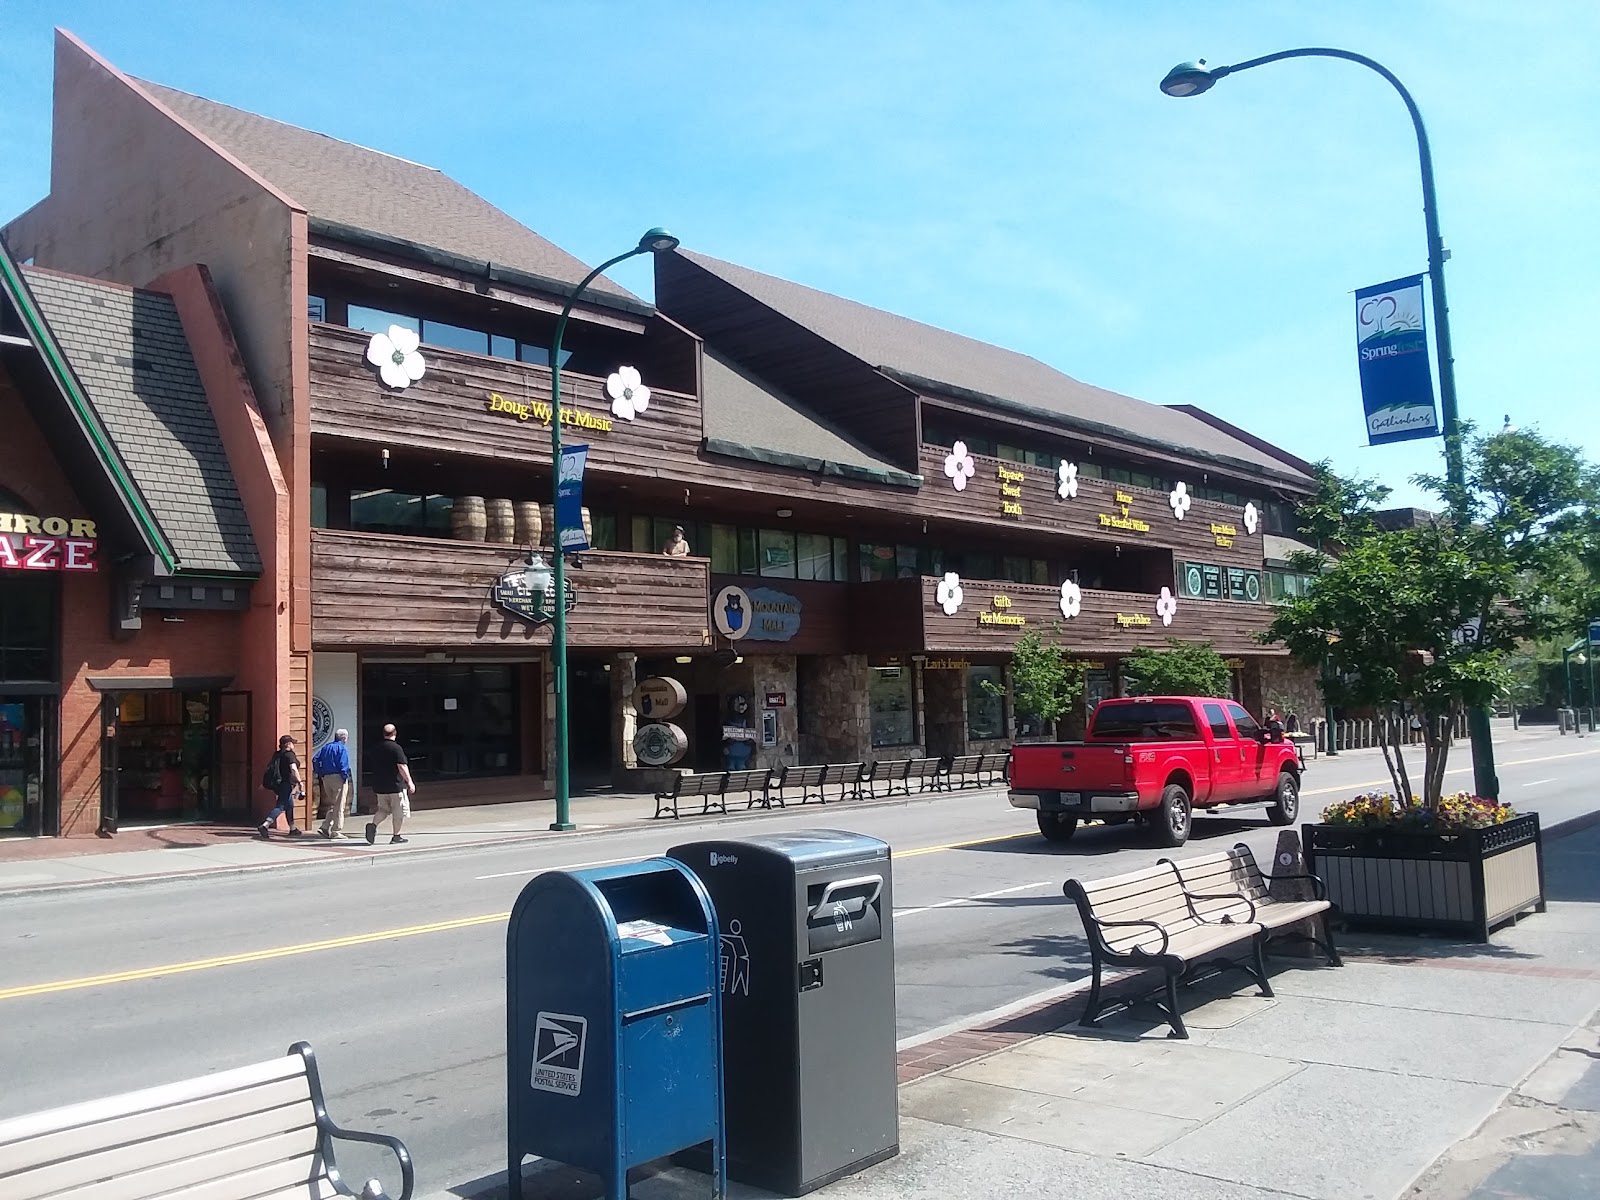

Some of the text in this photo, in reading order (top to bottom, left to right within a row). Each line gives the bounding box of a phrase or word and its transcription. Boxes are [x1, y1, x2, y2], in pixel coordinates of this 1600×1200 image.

[490, 392, 613, 432] Doug Wytt Music
[1371, 412, 1431, 431] Gatlinburg
[1002, 484, 1021, 498] Sweet
[1116, 489, 1133, 504] Home
[1003, 501, 1022, 515] Tooth
[1121, 504, 1129, 519] by
[1099, 513, 1150, 532] The Scented Willow
[993, 594, 1012, 608] Gifts
[980, 611, 1026, 625] For Memories
[1116, 612, 1152, 628] Pepper Palace
[640, 684, 667, 693] Mountain
[655, 698, 669, 706] Mall
[710, 851, 739, 867] Bigbelly
[535, 1068, 576, 1082] UNITED STATES
[534, 1076, 578, 1092] POSTAL SERVICE
